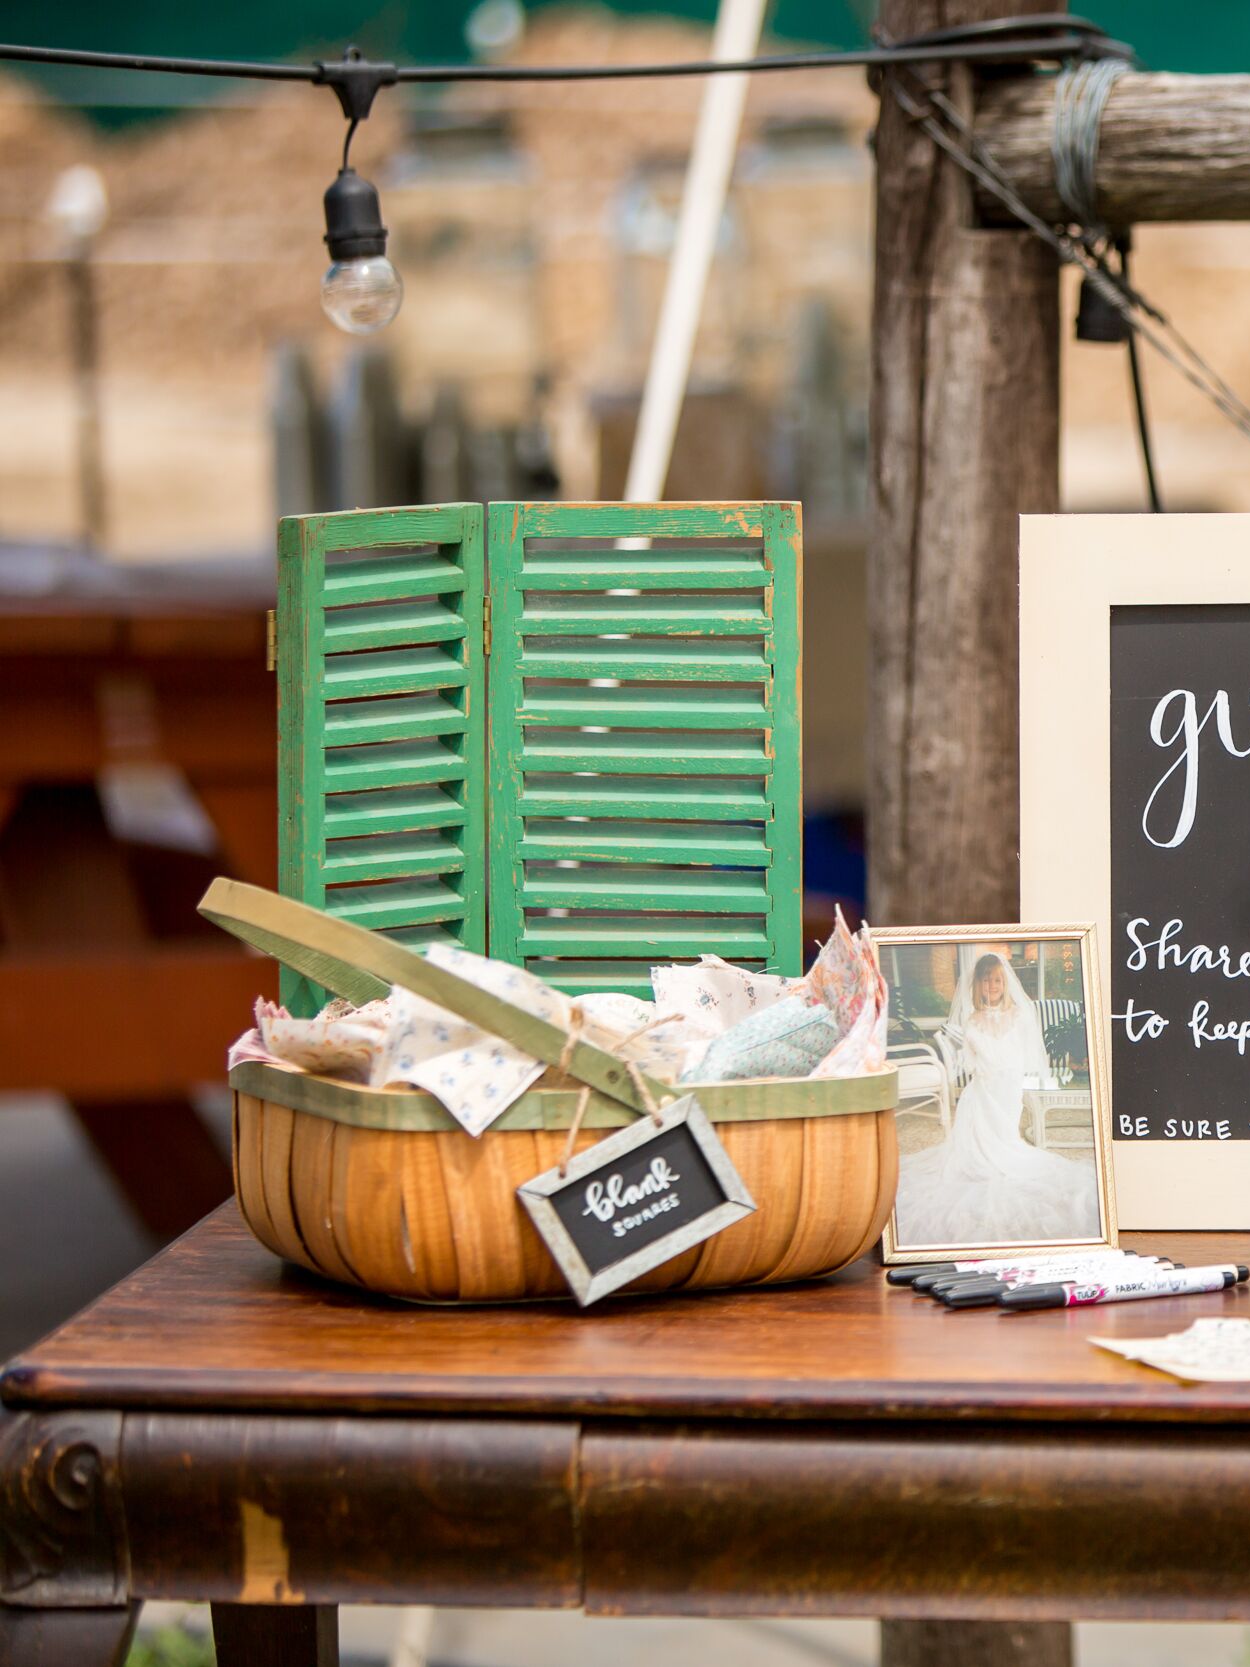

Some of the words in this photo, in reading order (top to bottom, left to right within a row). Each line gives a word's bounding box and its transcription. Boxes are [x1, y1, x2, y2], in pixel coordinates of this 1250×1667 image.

[1112, 999, 1169, 1043] to
[1119, 1114, 1150, 1137] BE
[1164, 1118, 1231, 1140] SURE
[581, 1156, 681, 1223] blank
[611, 1193, 681, 1238] SQUARES
[1076, 1289, 1099, 1301] TULIP
[1115, 1281, 1146, 1295] FABRIC
